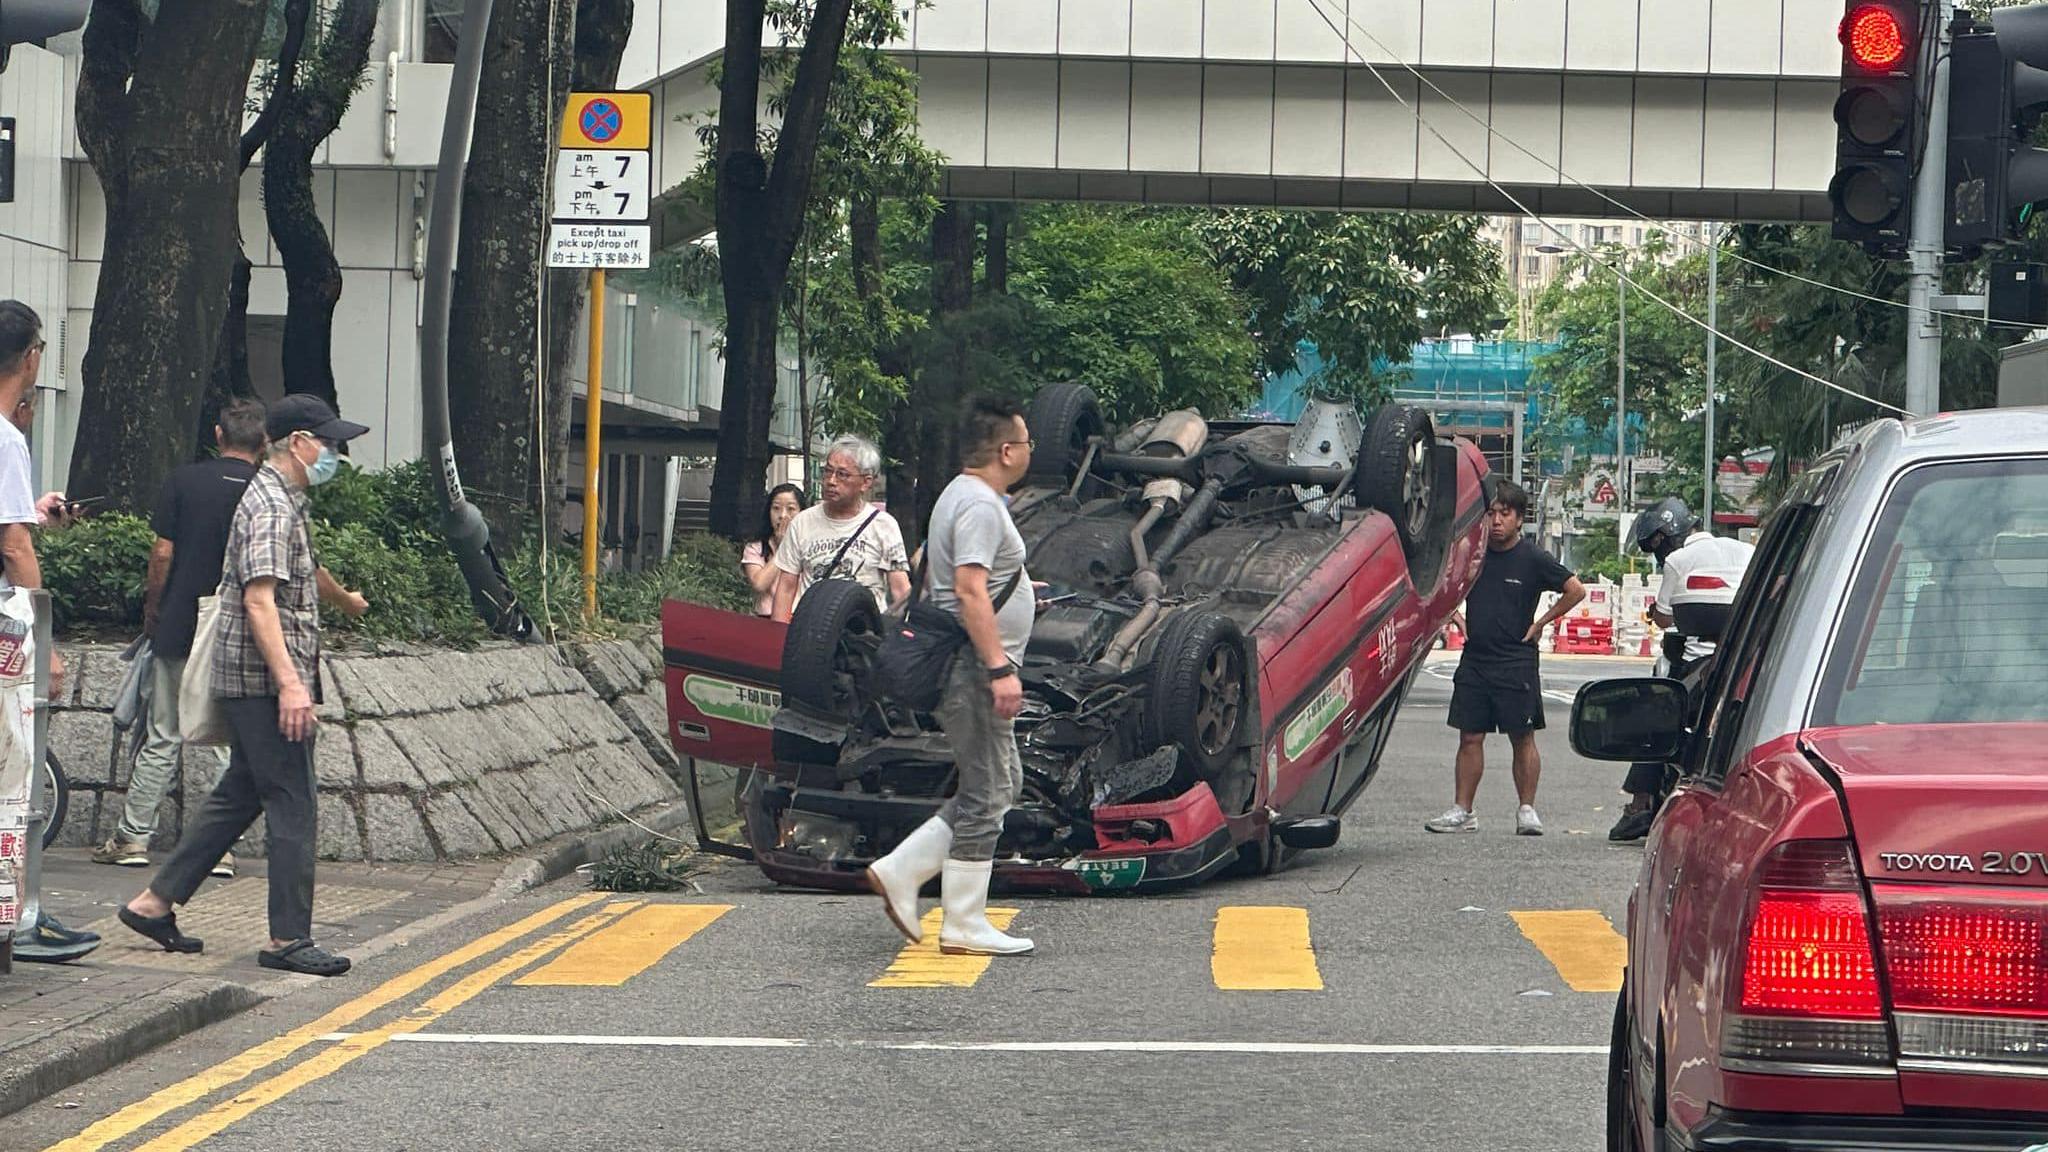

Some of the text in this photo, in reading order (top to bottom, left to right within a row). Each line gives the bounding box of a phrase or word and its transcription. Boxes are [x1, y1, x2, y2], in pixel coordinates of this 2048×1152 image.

[576, 154, 593, 162] am
[570, 165, 599, 178] 上午
[615, 156, 631, 178] 7
[575, 191, 592, 200] pm
[569, 202, 598, 215] 下午
[614, 193, 630, 215] 7
[571, 228, 626, 238] Except taxi
[557, 239, 638, 249] pick up/drop off
[553, 251, 643, 265] 的士上落客除外
[1081, 861, 1129, 871] SEATS
[1880, 853, 1974, 871] TOYOTA
[1100, 872, 1114, 886] 4
